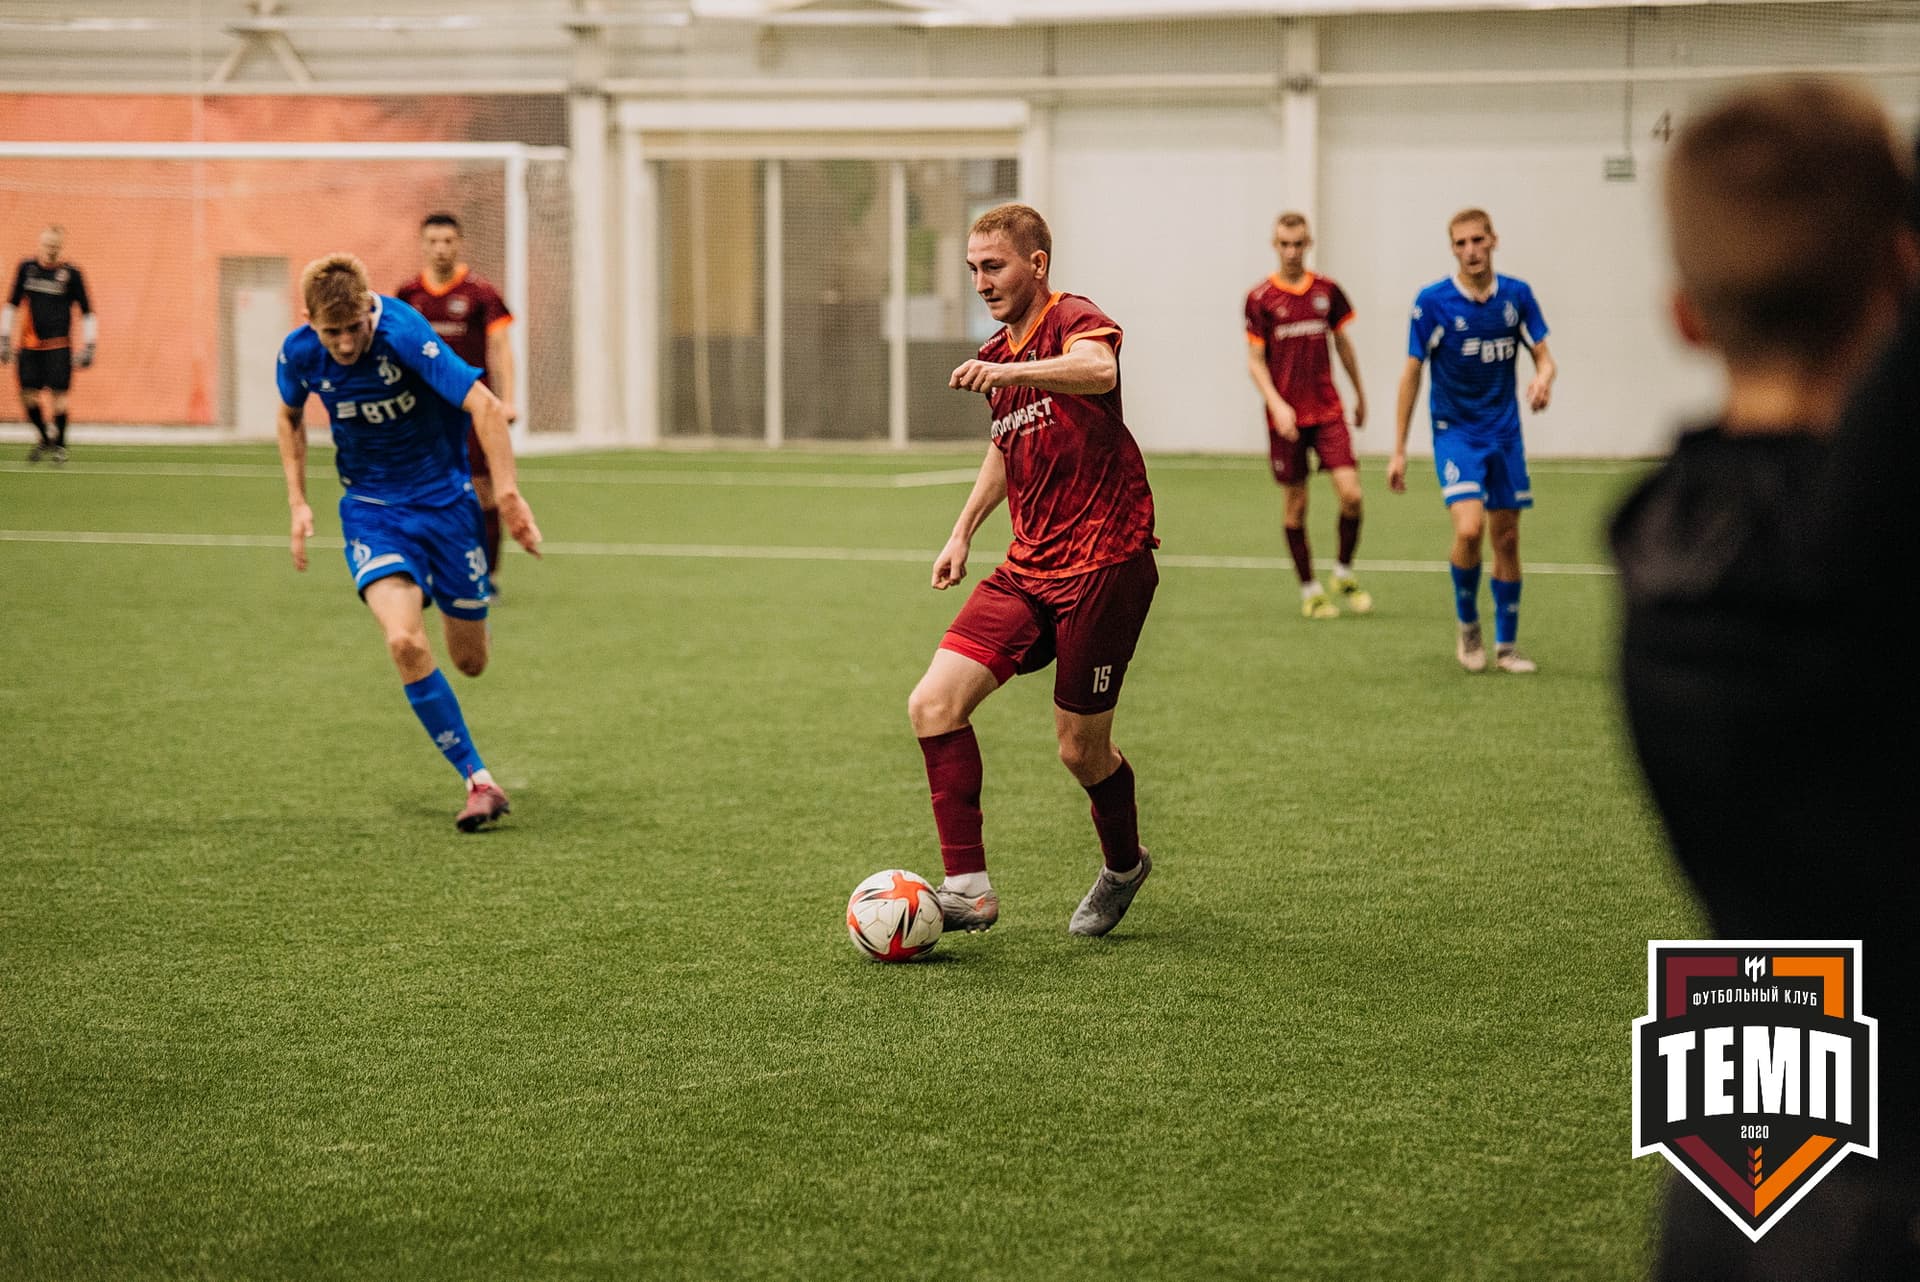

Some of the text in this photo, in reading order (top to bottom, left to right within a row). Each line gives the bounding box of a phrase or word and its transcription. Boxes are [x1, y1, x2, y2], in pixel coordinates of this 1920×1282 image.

[1652, 108, 1672, 143] 4
[361, 392, 416, 423] ВТБ
[1092, 665, 1112, 694] 15
